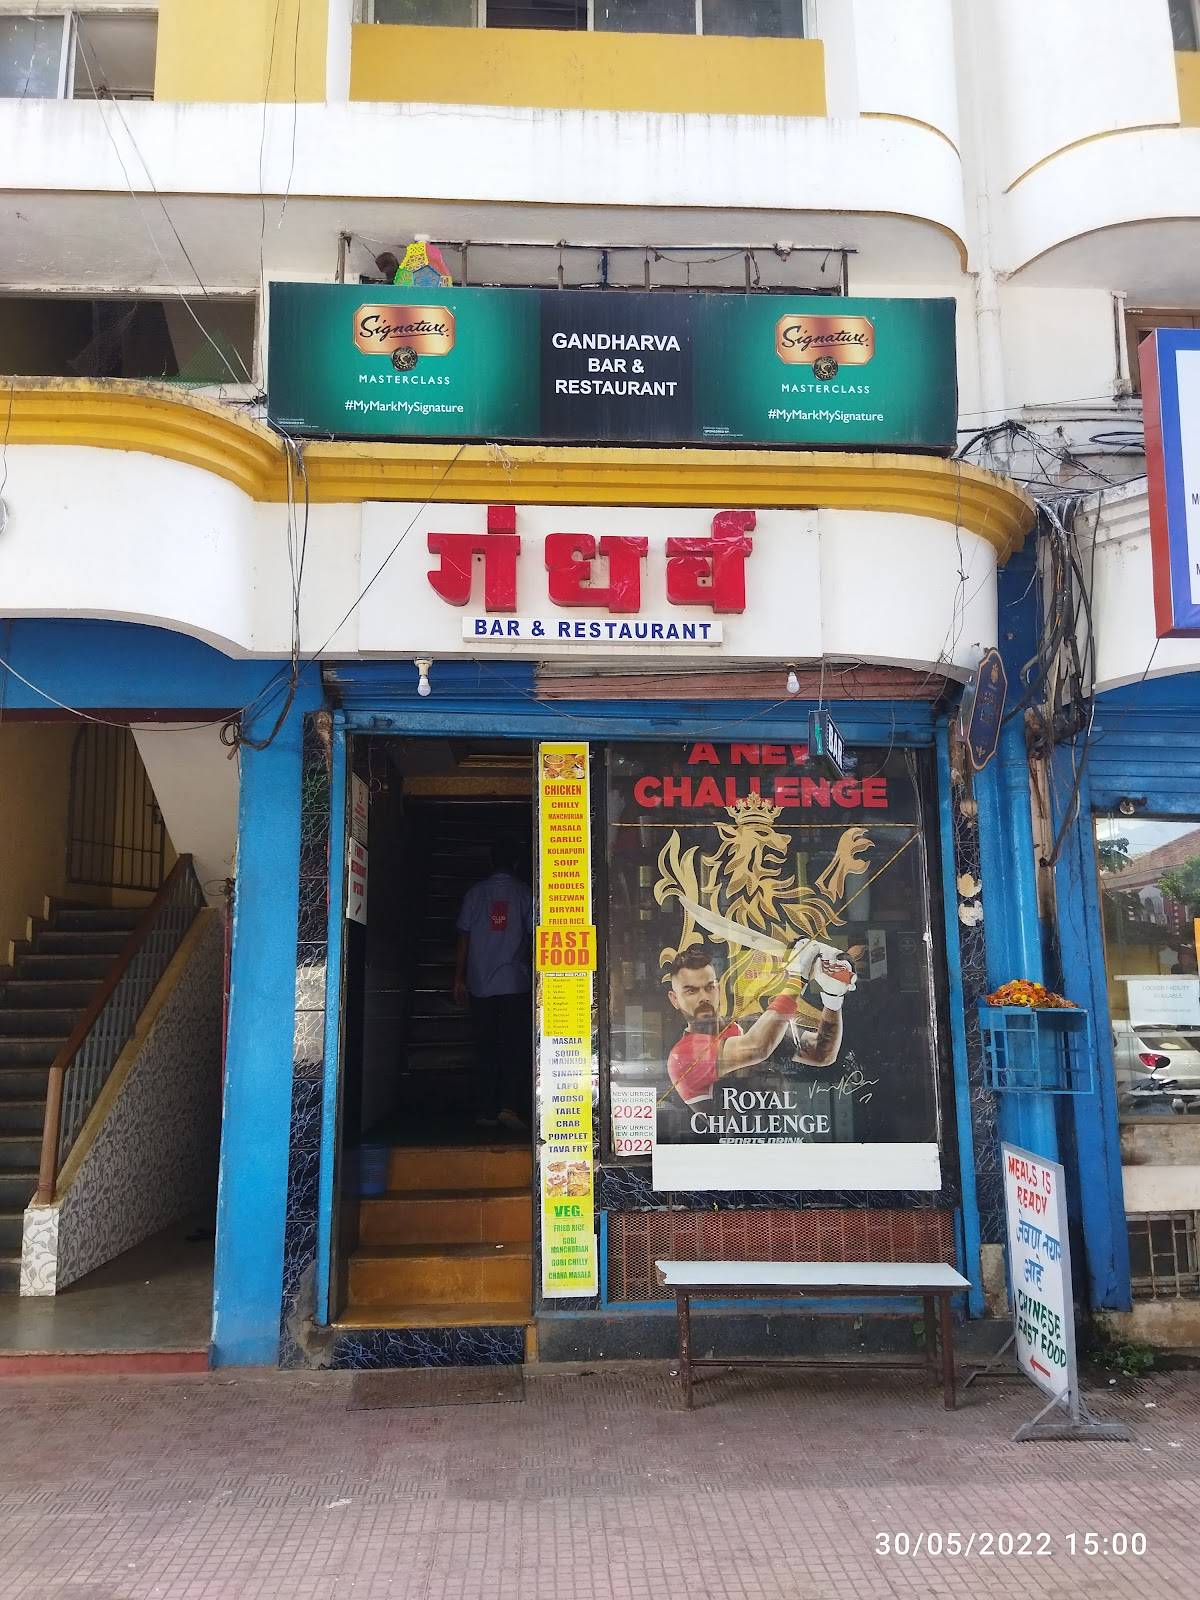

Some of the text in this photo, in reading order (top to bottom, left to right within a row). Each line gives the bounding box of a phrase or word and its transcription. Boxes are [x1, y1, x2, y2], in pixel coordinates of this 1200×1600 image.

[360, 315, 449, 342] Signature
[552, 332, 681, 352] GANDHARVA
[782, 325, 869, 352] Signature
[588, 357, 645, 374] BAR &
[359, 374, 450, 385] MASTERCLASS
[555, 379, 678, 397] RESTAURANT
[781, 383, 870, 394] MASTERCLASS
[344, 399, 464, 415] #MyMarkMySignature
[767, 408, 884, 424] #MyMarkMySignature
[427, 505, 756, 614] गंधर्व
[474, 619, 712, 640] BAR & RESTAURANT
[688, 742, 720, 765] A
[828, 722, 843, 770] BAR
[544, 784, 582, 796] CHICKEN
[633, 775, 888, 808] CHALLENGE
[547, 847, 585, 855] KOLHAPURI
[553, 859, 579, 867] SOUP
[548, 882, 585, 890] NOODLES
[548, 894, 585, 902] SHEZWAN
[569, 917, 585, 925] RICE
[540, 931, 590, 949] FAST
[540, 948, 590, 966] FOOD
[552, 1037, 583, 1045] MASALA
[614, 1105, 652, 1119] 2022
[556, 1120, 580, 1128] CRAB
[690, 1111, 831, 1134] CHALLENGE
[548, 1132, 588, 1140] POMPLET
[549, 1145, 588, 1153] TAVA FRY
[616, 1139, 652, 1152] 2022
[1008, 1155, 1052, 1195] MEALS IS
[1017, 1185, 1048, 1216] READY
[554, 1205, 583, 1218] VEG.
[1018, 1288, 1062, 1340] CHINESE
[1018, 1316, 1067, 1368] FAST FOOD
